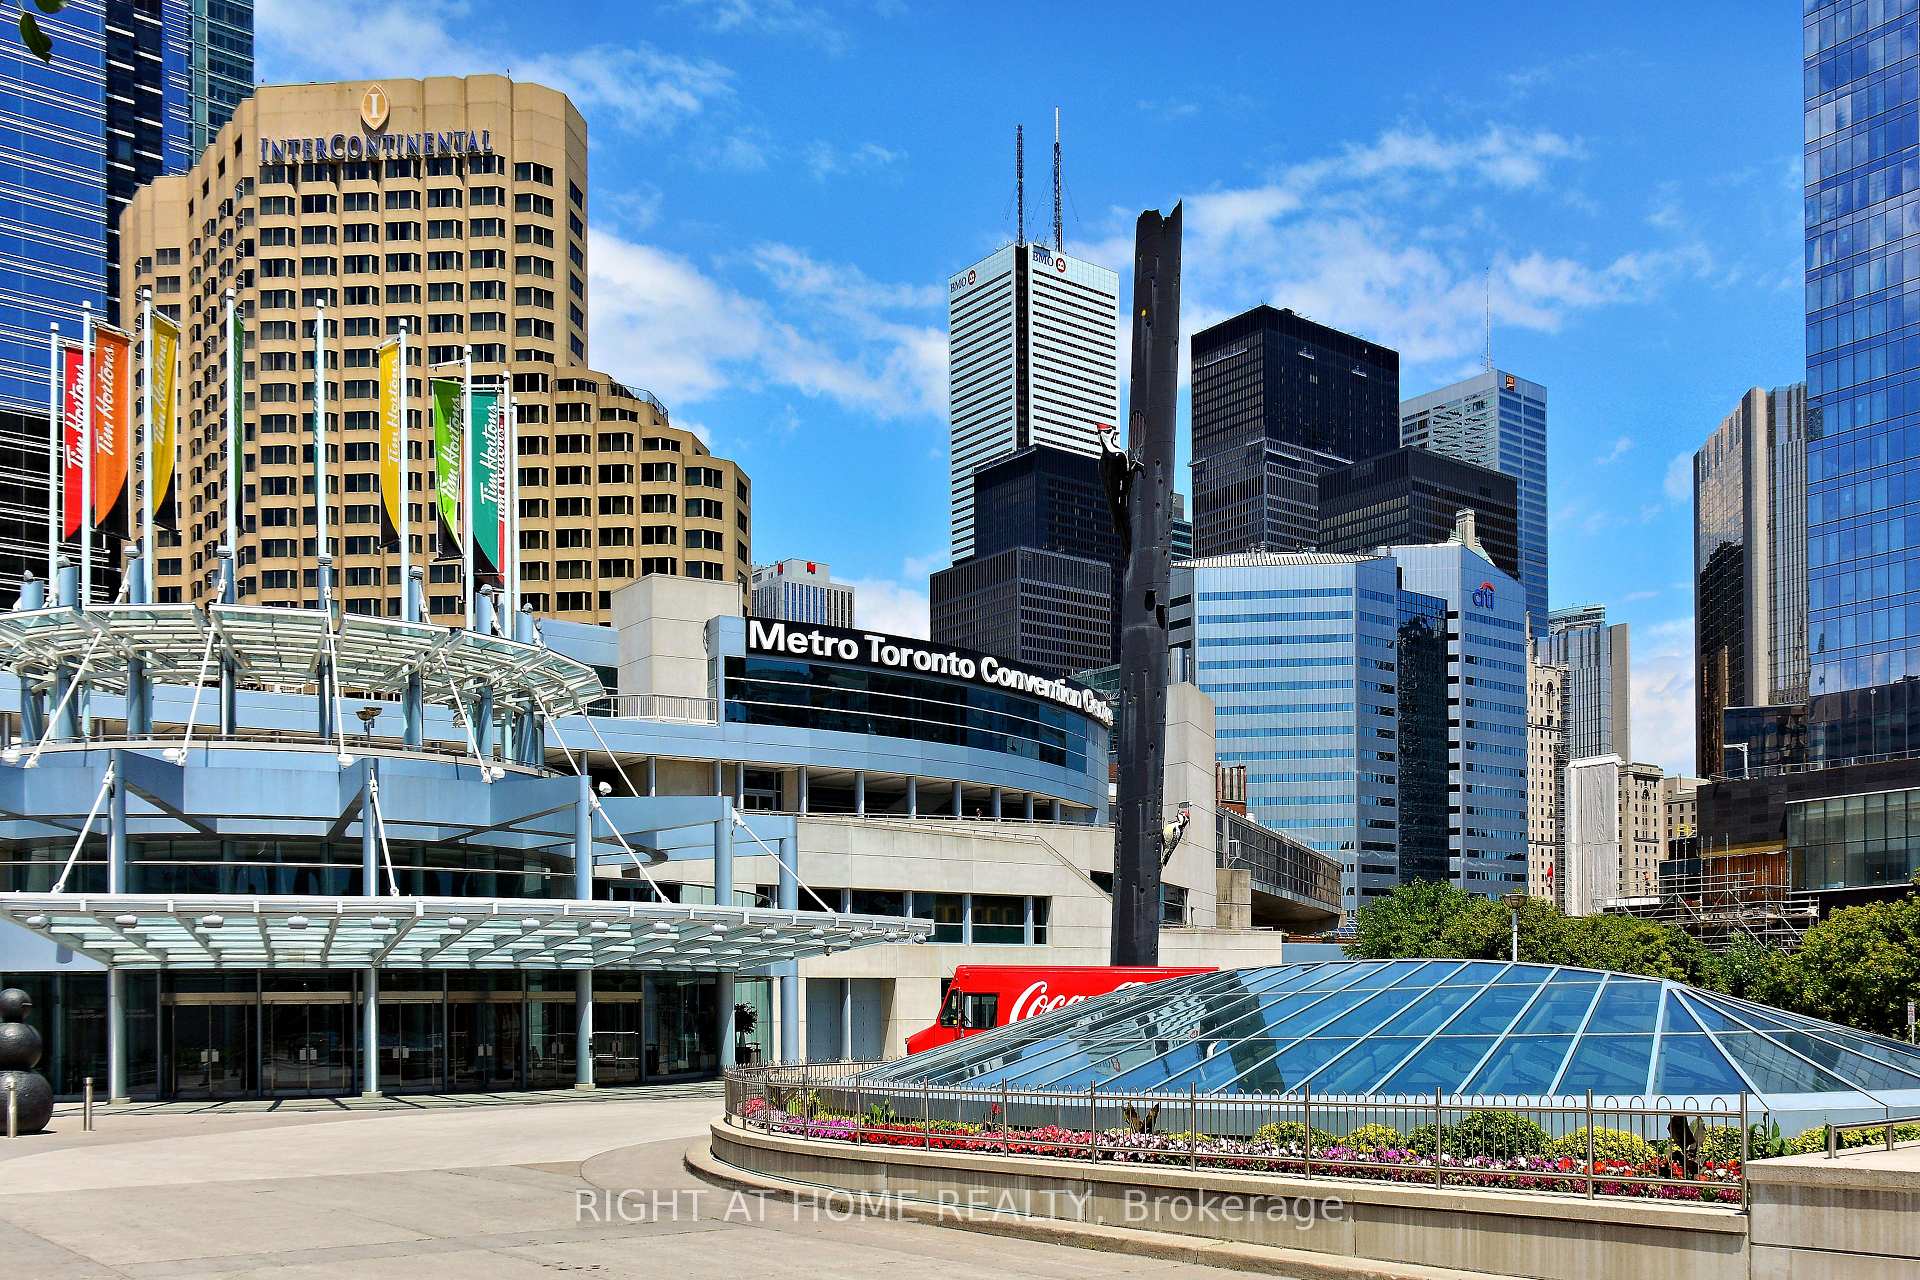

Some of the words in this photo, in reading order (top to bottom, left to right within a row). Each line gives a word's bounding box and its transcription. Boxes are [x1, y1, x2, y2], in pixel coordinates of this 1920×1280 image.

[260, 130, 493, 161] INTERCONTINENTAL
[1033, 252, 1054, 267] BMO
[950, 277, 967, 293] BMO
[95, 421, 115, 456] Tim
[153, 412, 166, 446] Tim
[65, 436, 83, 469] Tim
[387, 432, 400, 466] Tim
[440, 467, 457, 501] Tim
[480, 472, 498, 505] Tim
[1472, 585, 1495, 609] citi
[749, 620, 859, 660] Metro
[864, 634, 976, 679] Toronto
[980, 656, 1082, 709] Convention
